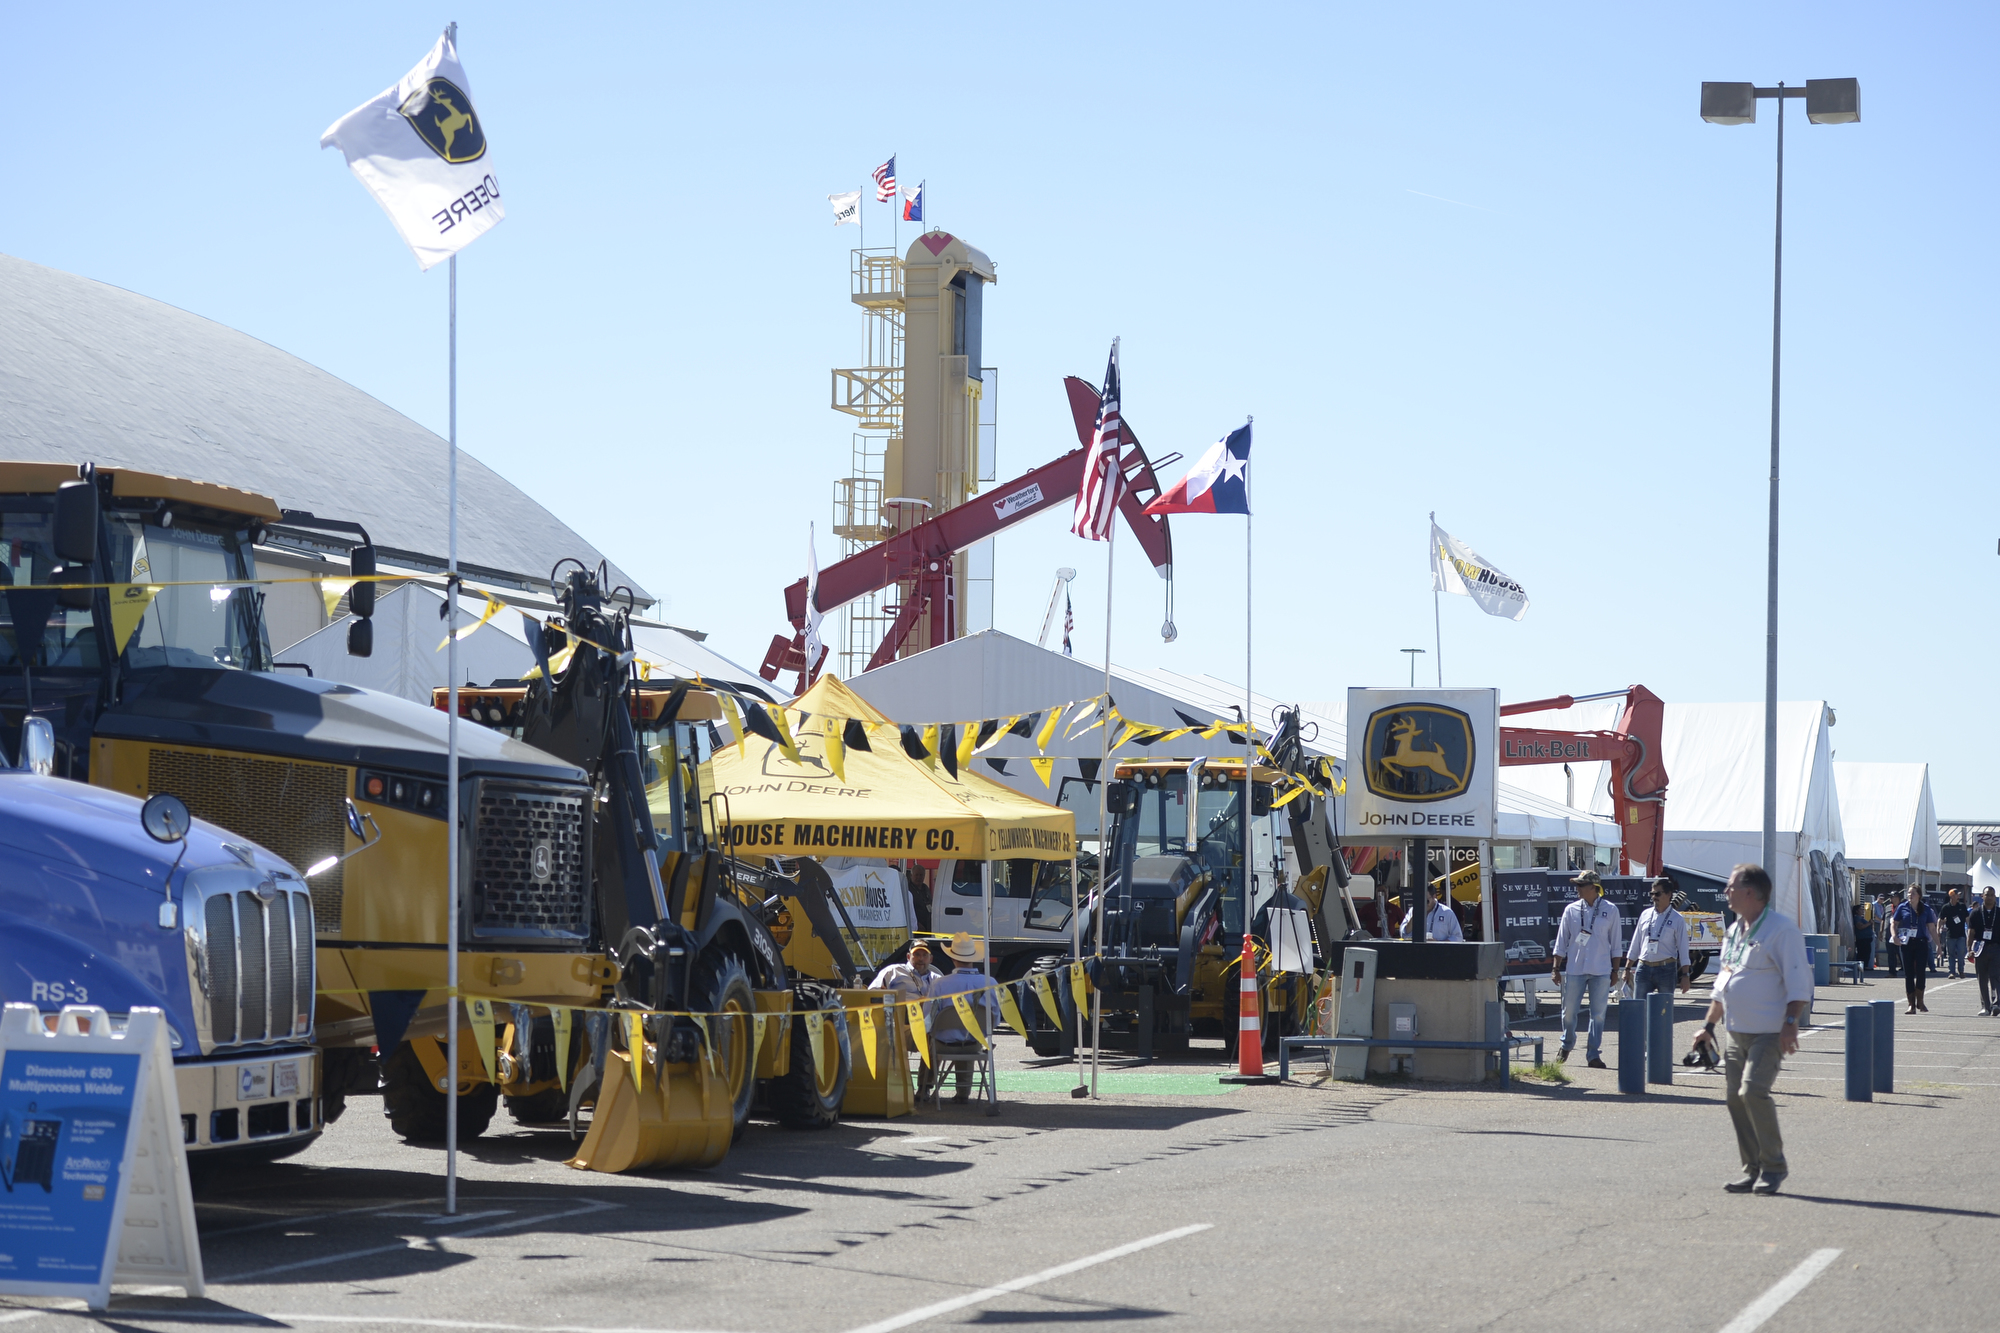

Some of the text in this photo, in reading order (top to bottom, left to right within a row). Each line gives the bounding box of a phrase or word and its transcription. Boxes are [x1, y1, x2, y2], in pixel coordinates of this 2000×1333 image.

[1006, 485, 1038, 504] Weatherford
[171, 526, 225, 546] JOHN DEERE
[723, 781, 872, 798] JOHN DEERE
[1359, 811, 1475, 827] JOHN DEERE
[793, 824, 917, 850] MACHINERY
[926, 828, 960, 851] CO.
[1032, 828, 1061, 851] MACHINERY
[1427, 845, 1480, 862] ervices
[736, 872, 758, 884] ERE
[1502, 884, 1542, 892] SEWELL
[1604, 888, 1639, 896] SEWELL
[1505, 916, 1542, 927] FLEET
[1620, 917, 1638, 926] EET
[754, 927, 775, 967] 310SL
[32, 981, 89, 1003] RS-3
[25, 1064, 113, 1080] Dimension 650
[8, 1079, 125, 1096] Multiprocess Welder
[64, 1156, 110, 1170] ArcReach
[62, 1170, 108, 1184] Technology
